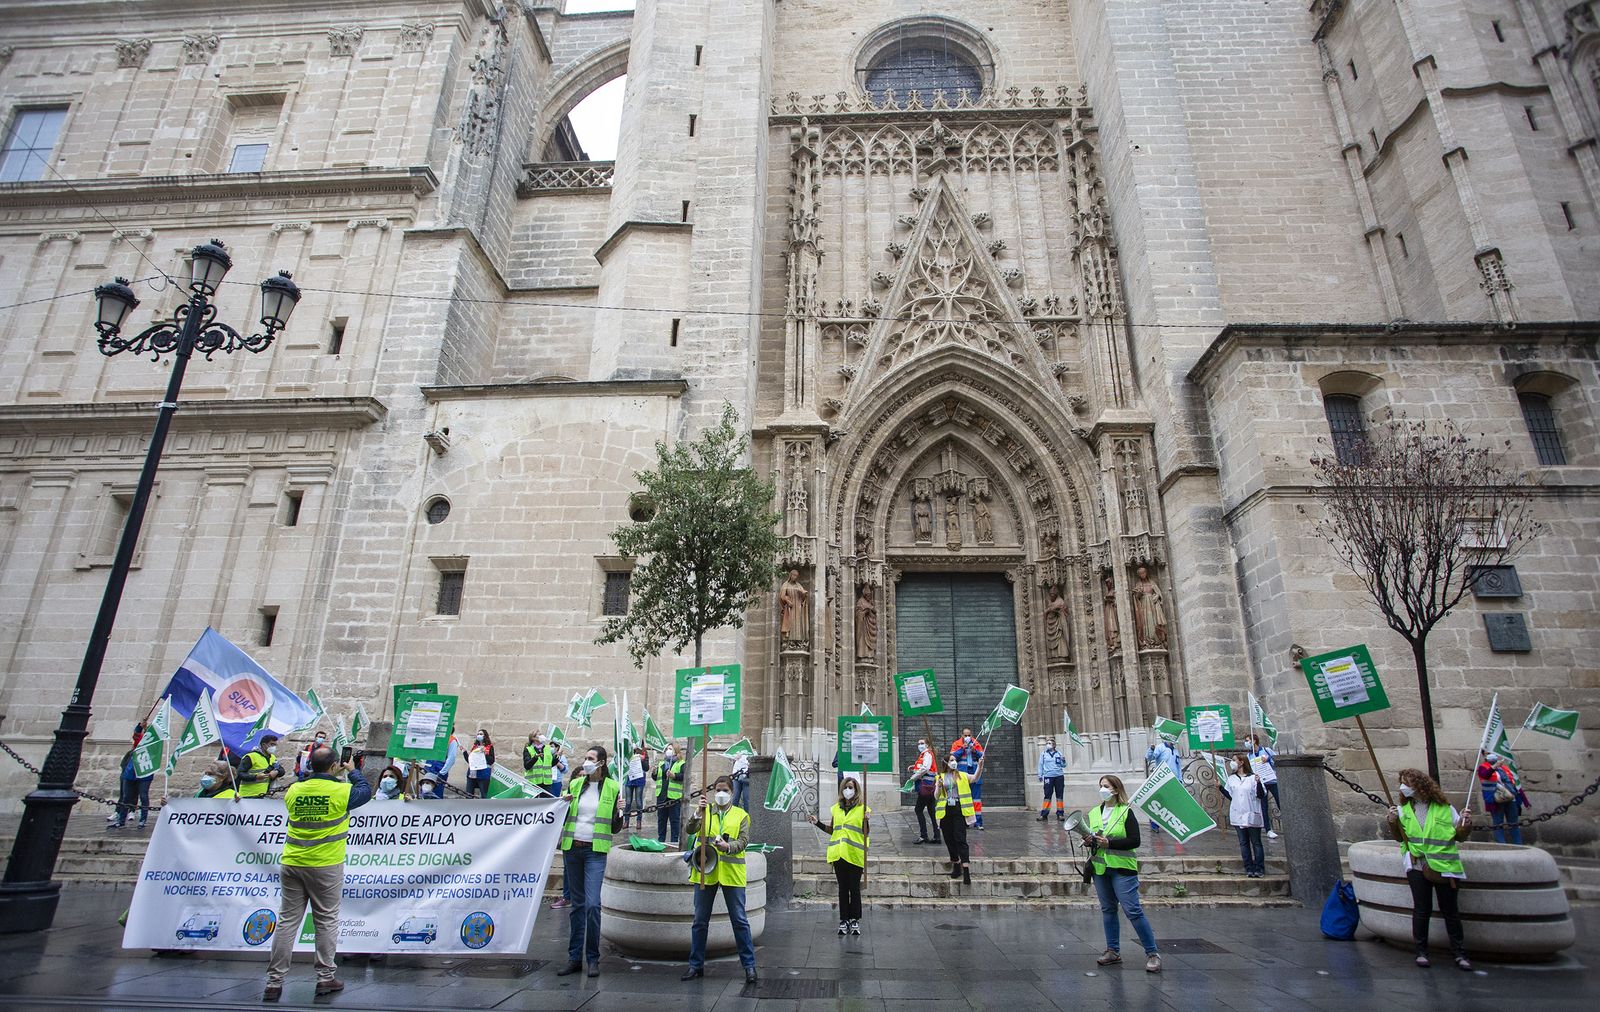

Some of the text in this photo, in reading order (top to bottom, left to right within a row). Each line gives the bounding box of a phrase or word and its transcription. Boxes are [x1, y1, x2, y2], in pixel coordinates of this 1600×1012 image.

[228, 691, 257, 711] SUAP
[295, 796, 330, 806] SATSE
[168, 813, 283, 827] PROFESIONALES
[349, 815, 397, 828] OSITIVO
[401, 815, 420, 827] DE
[422, 814, 471, 827] APOYO
[475, 812, 555, 826] URGENCIAS
[1147, 800, 1190, 836] SATSE
[257, 832, 455, 845] ATE RIMARIA SEVILLA
[344, 854, 415, 866] ABORALES
[418, 853, 472, 866] DIGNAS
[145, 871, 241, 882] RECONOCIMIENTO
[244, 873, 280, 883] SALAR
[344, 874, 404, 884] SPECIALES
[407, 874, 481, 884] CONDICIONES
[484, 874, 500, 884] DE
[163, 886, 208, 897] NOCHES,
[212, 886, 269, 898] FESTIVOS,
[342, 888, 424, 899] PELIGROSIDAD
[427, 888, 435, 898] Y
[437, 888, 499, 898] PENOSIDAD
[503, 888, 533, 900] ¡¡YA!!
